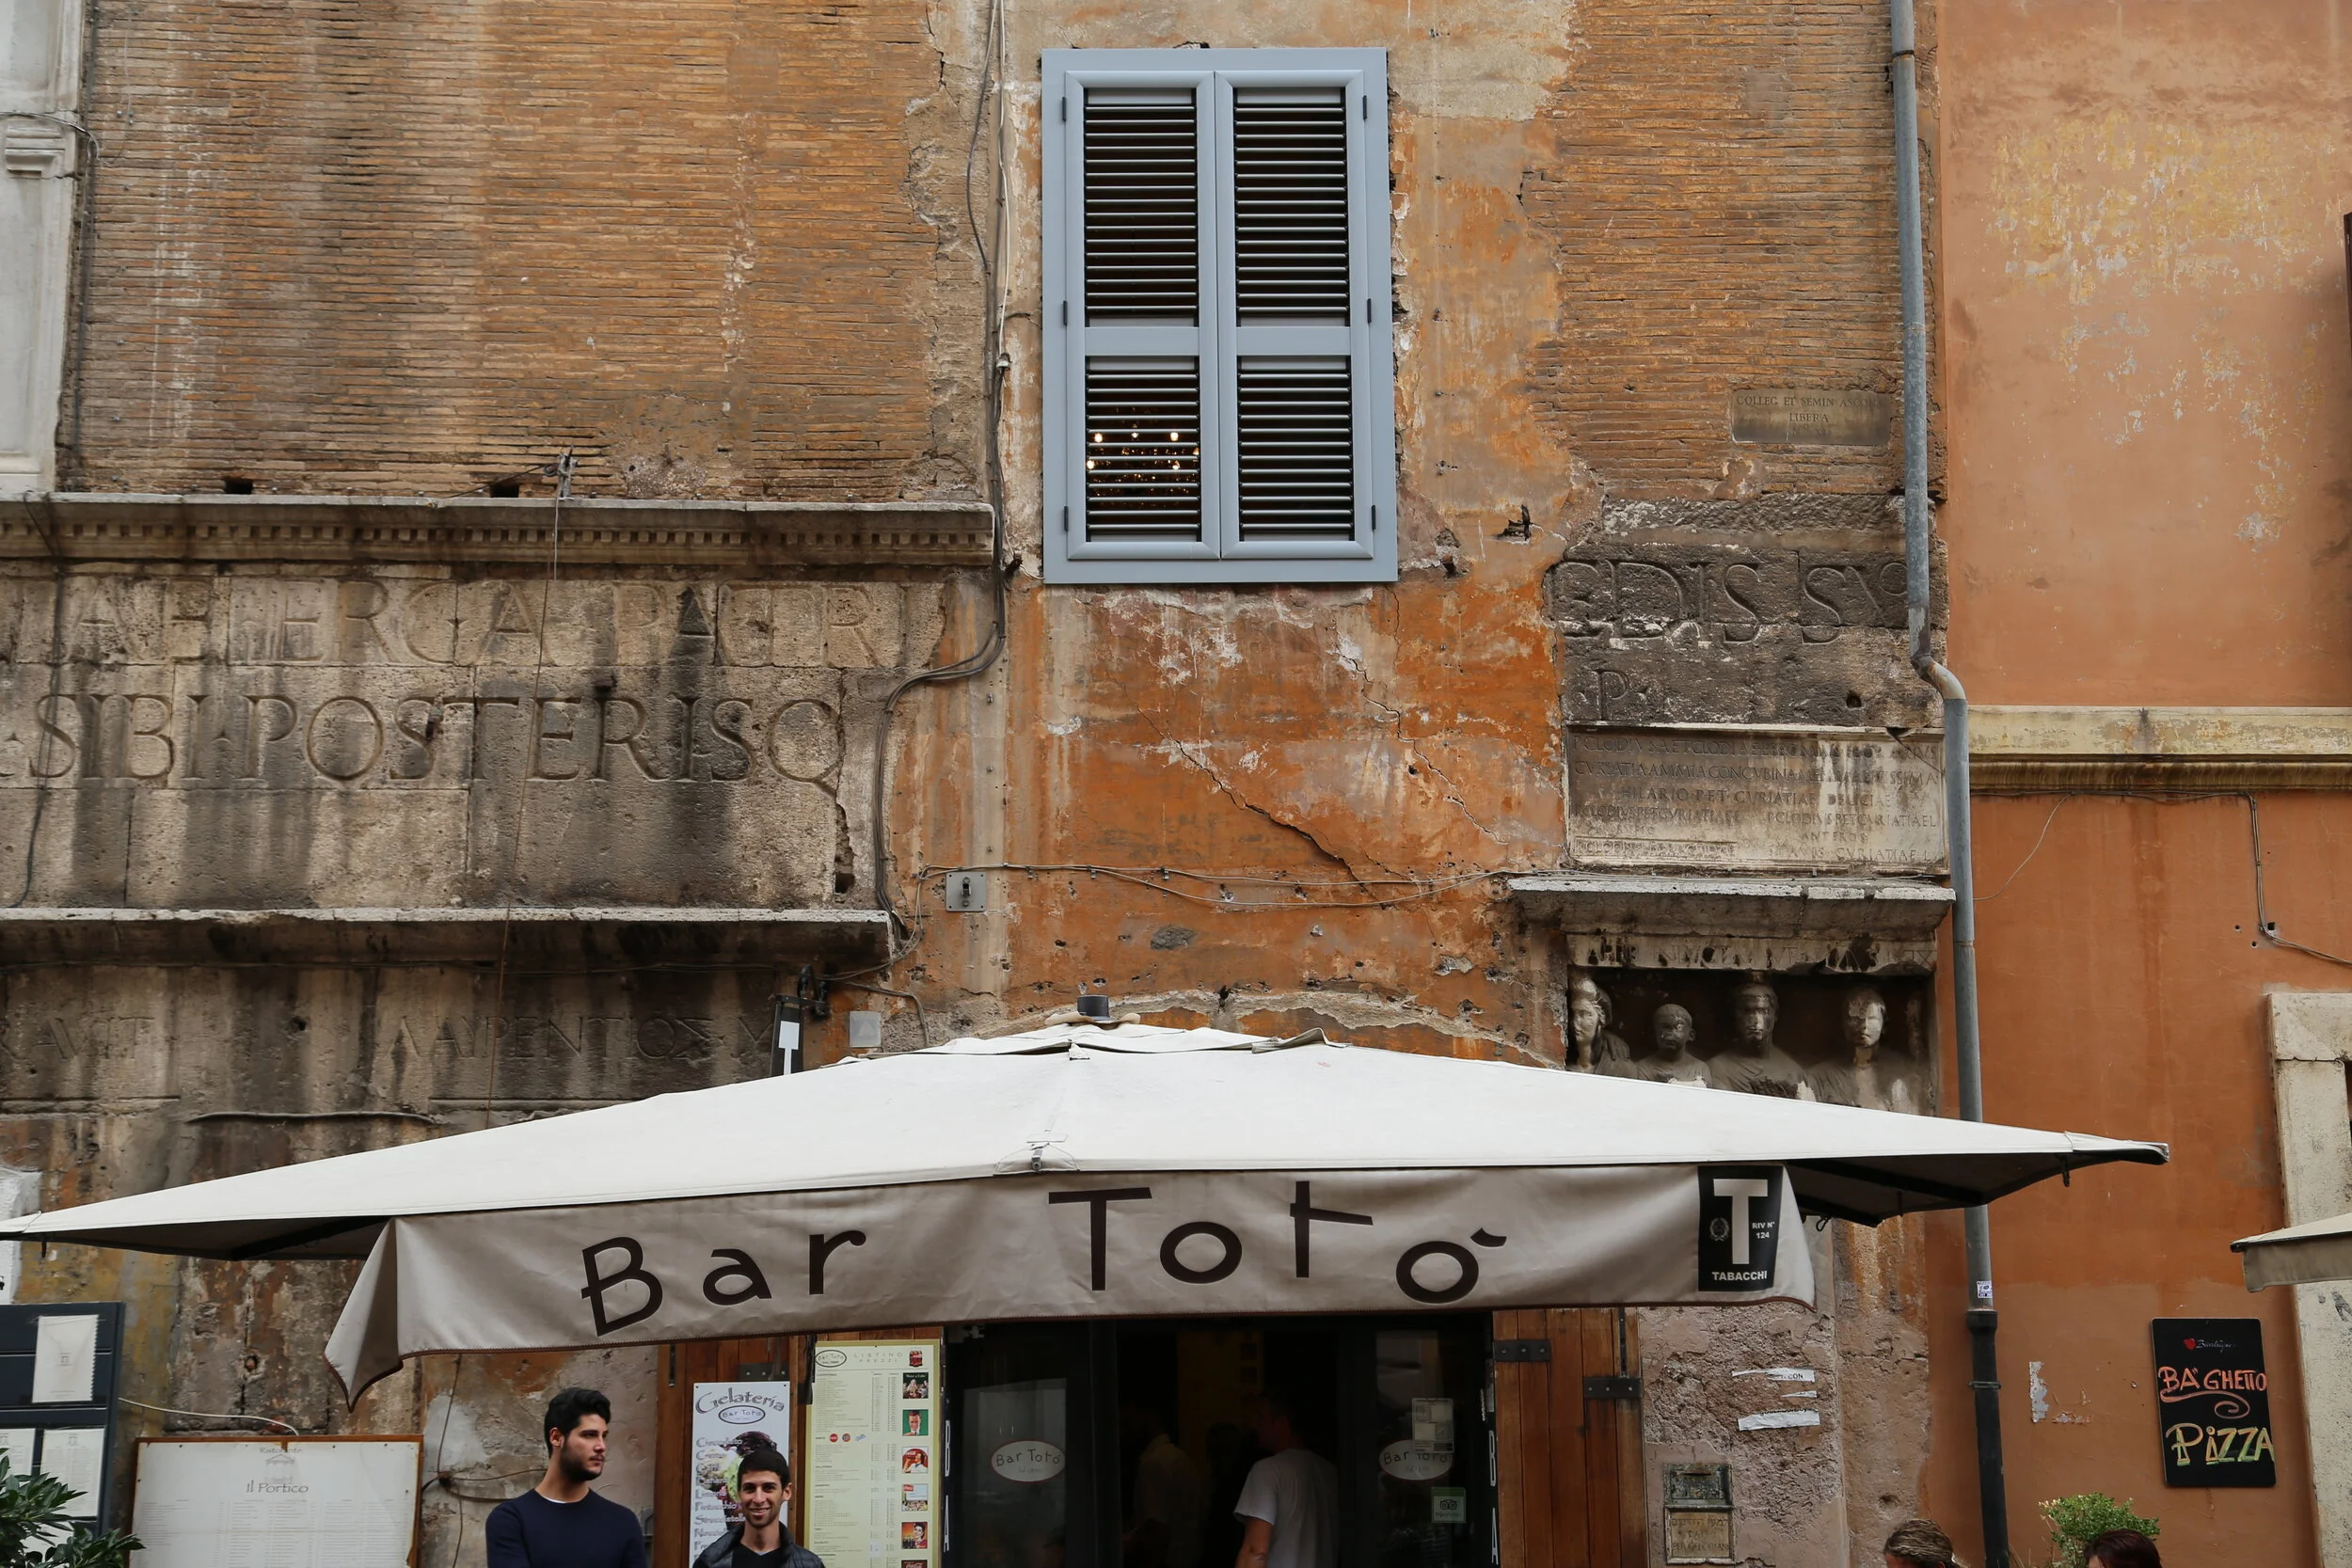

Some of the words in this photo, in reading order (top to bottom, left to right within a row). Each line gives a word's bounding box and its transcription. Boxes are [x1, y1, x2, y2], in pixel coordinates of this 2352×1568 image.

[1784, 397, 1796, 406] ET
[1801, 397, 1835, 406] SEMIN
[1789, 412, 1829, 422] LIBERA
[1713, 1179, 1768, 1264] T
[1712, 1271, 1767, 1281] TABACCHI
[581, 1236, 867, 1338] Bar
[995, 1453, 1023, 1467] Bar
[1383, 1451, 1410, 1465] Bar
[258, 1482, 309, 1493] Portico
